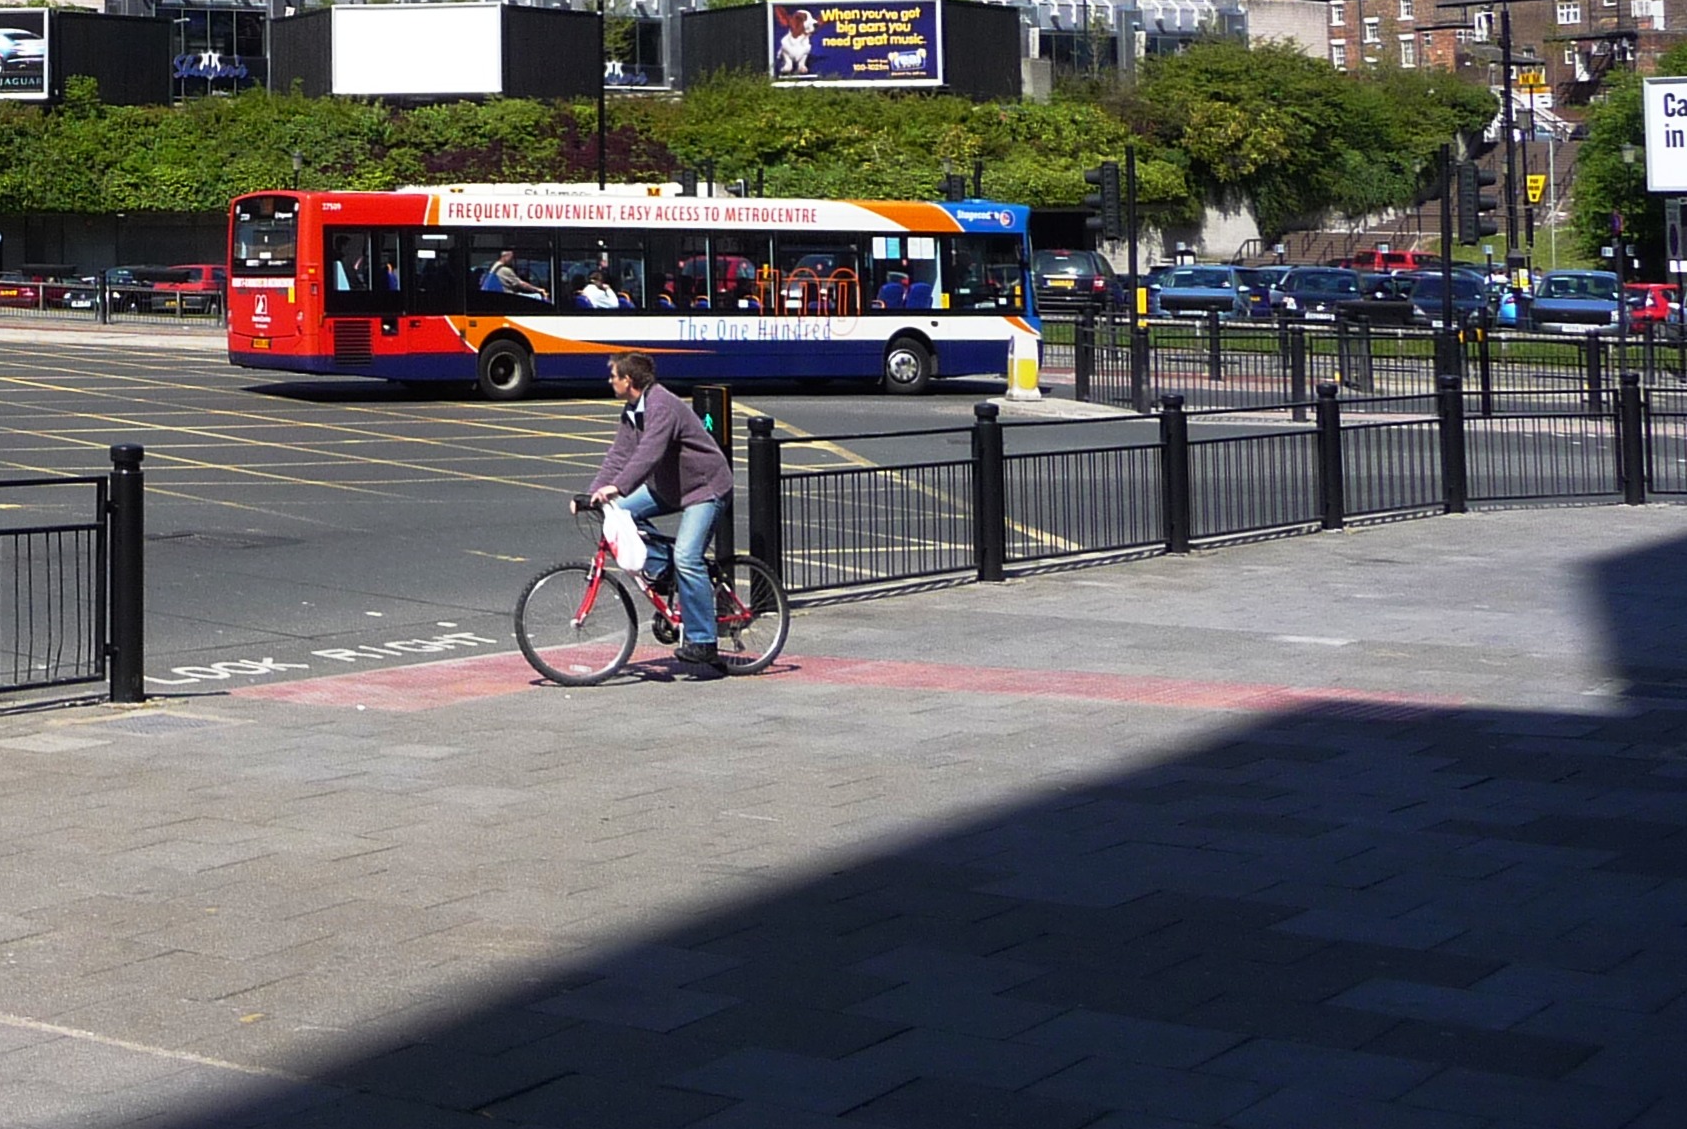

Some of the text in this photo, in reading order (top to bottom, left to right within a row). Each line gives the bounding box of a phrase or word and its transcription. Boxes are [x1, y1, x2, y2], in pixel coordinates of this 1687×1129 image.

[821, 7, 921, 22] When you've got
[836, 21, 911, 34] big ears you
[822, 36, 851, 47] need
[852, 34, 888, 49] great
[0, 76, 43, 87] JAGUAR
[1665, 123, 1685, 148] in
[448, 203, 817, 223] FREQUENT, CONVENIENT, EASY ACCESS TO METROCENTRE
[678, 319, 832, 340] The One Hundred
[144, 632, 497, 686] LOOK RIGHT
